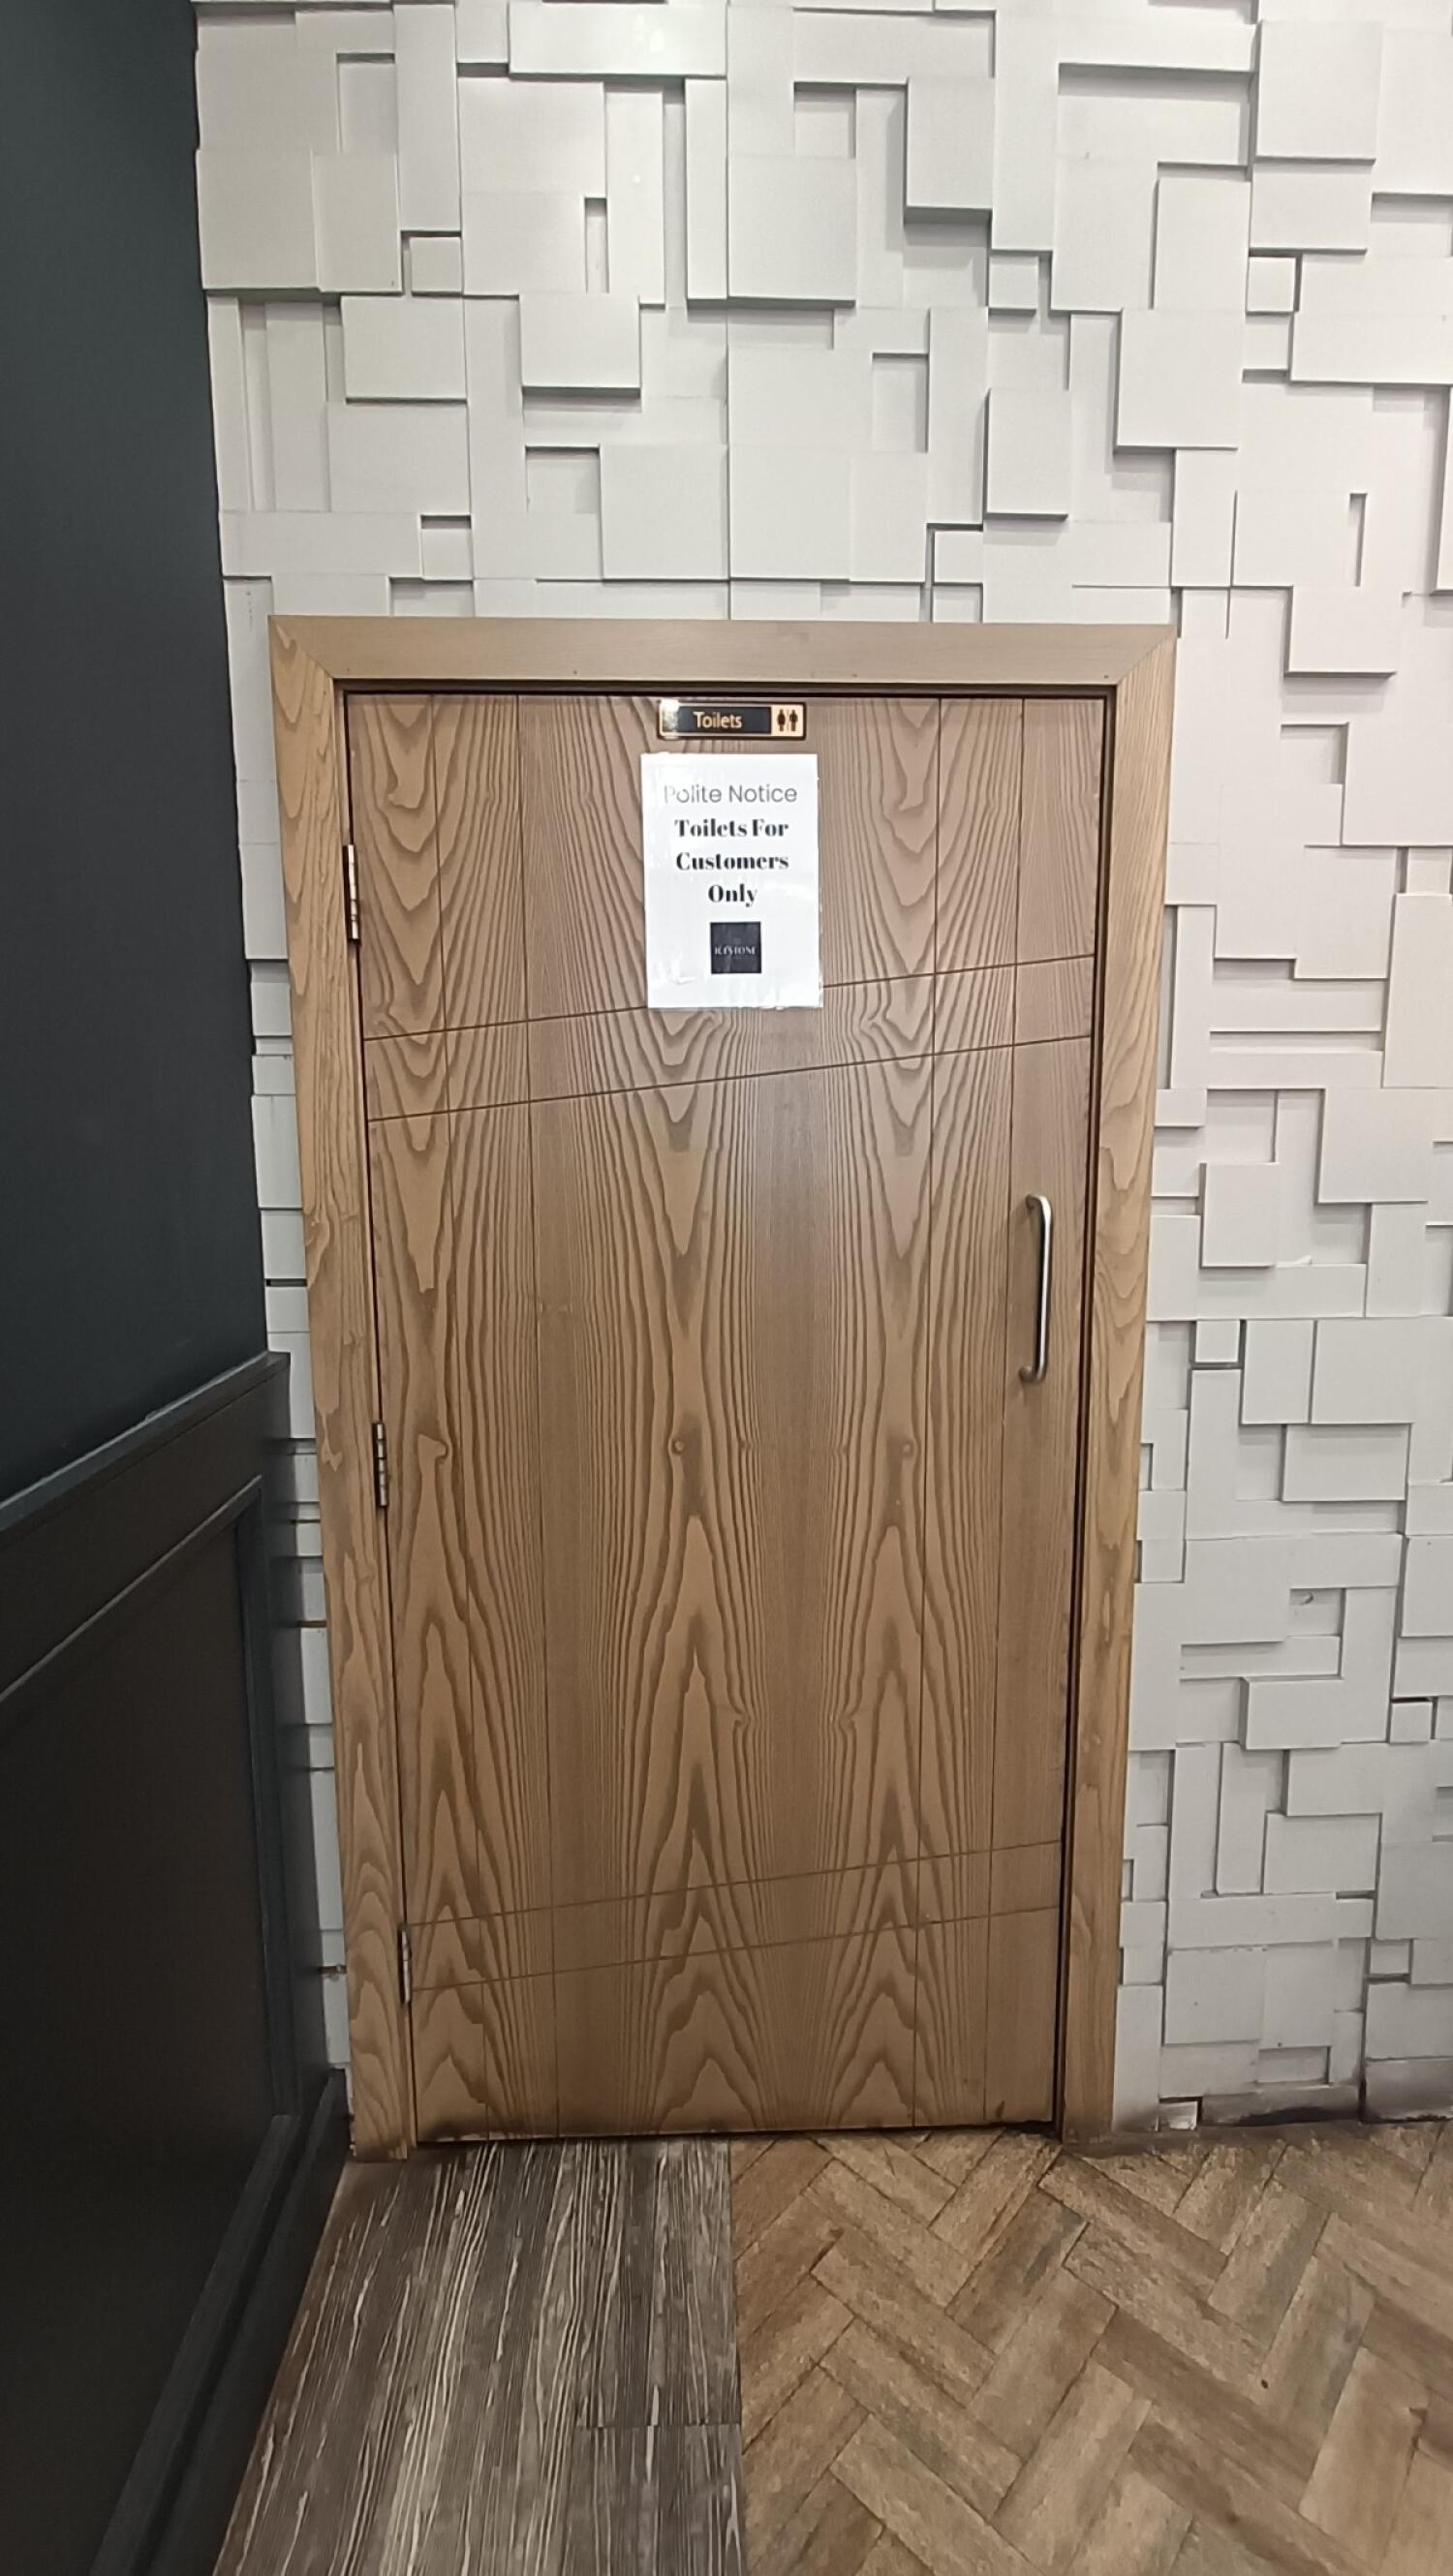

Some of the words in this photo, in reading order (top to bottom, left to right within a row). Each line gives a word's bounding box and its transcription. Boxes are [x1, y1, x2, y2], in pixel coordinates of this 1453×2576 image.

[693, 712, 742, 728] Toilets
[664, 784, 722, 803] Polite
[728, 784, 797, 803] Notice
[674, 818, 747, 838] Toilets
[752, 818, 789, 837] For
[676, 852, 789, 871] Customers
[708, 883, 757, 907] Only
